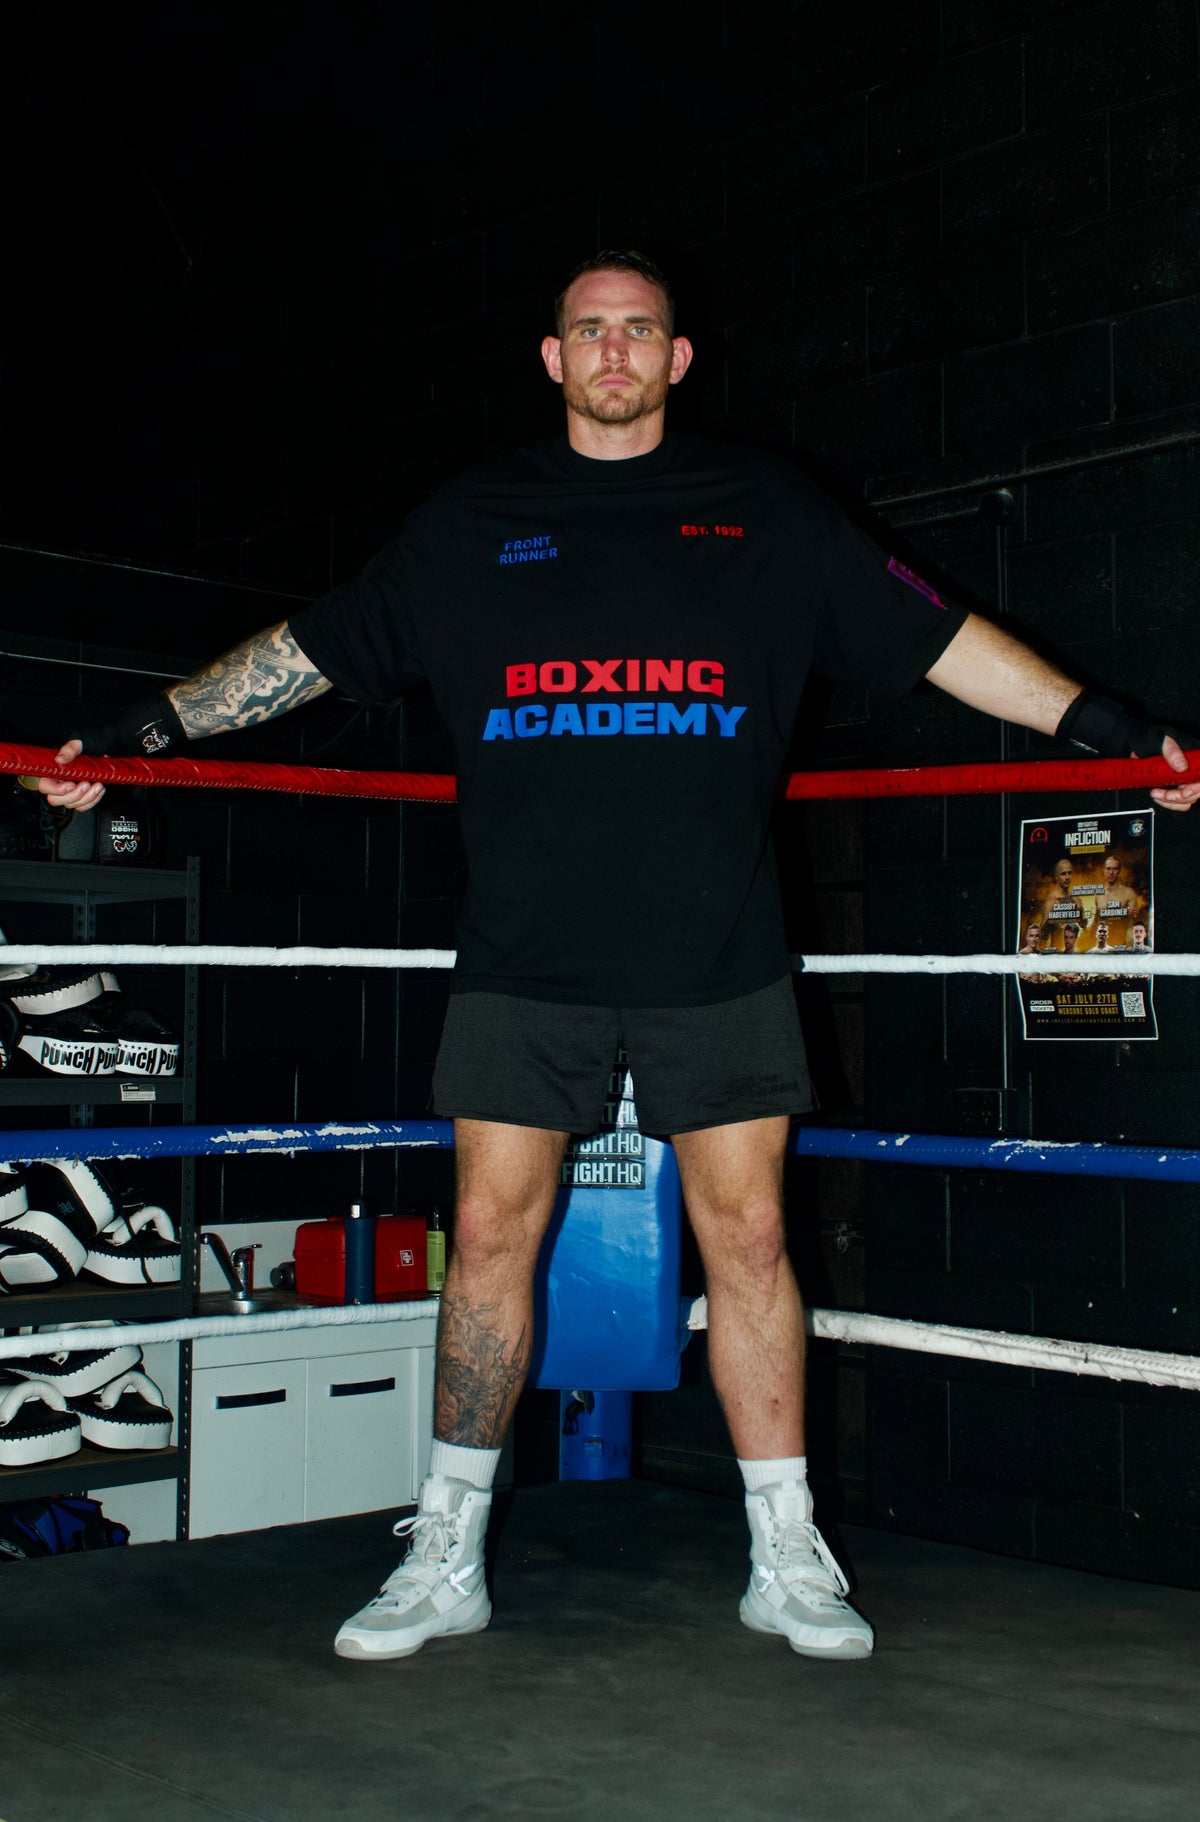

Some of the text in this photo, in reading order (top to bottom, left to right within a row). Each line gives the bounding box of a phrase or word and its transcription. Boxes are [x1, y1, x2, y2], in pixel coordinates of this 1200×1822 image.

[682, 525, 709, 536] EST.
[505, 536, 551, 552] FRONT
[500, 547, 558, 565] RUNNER
[506, 659, 724, 698] BOXING
[482, 702, 748, 740] ACADEMY
[1065, 830, 1110, 846] INFLICTION
[1056, 994, 1117, 1004] SAT JULY 27TH
[41, 1040, 95, 1074] PUNCH
[116, 1047, 157, 1074] UNCH
